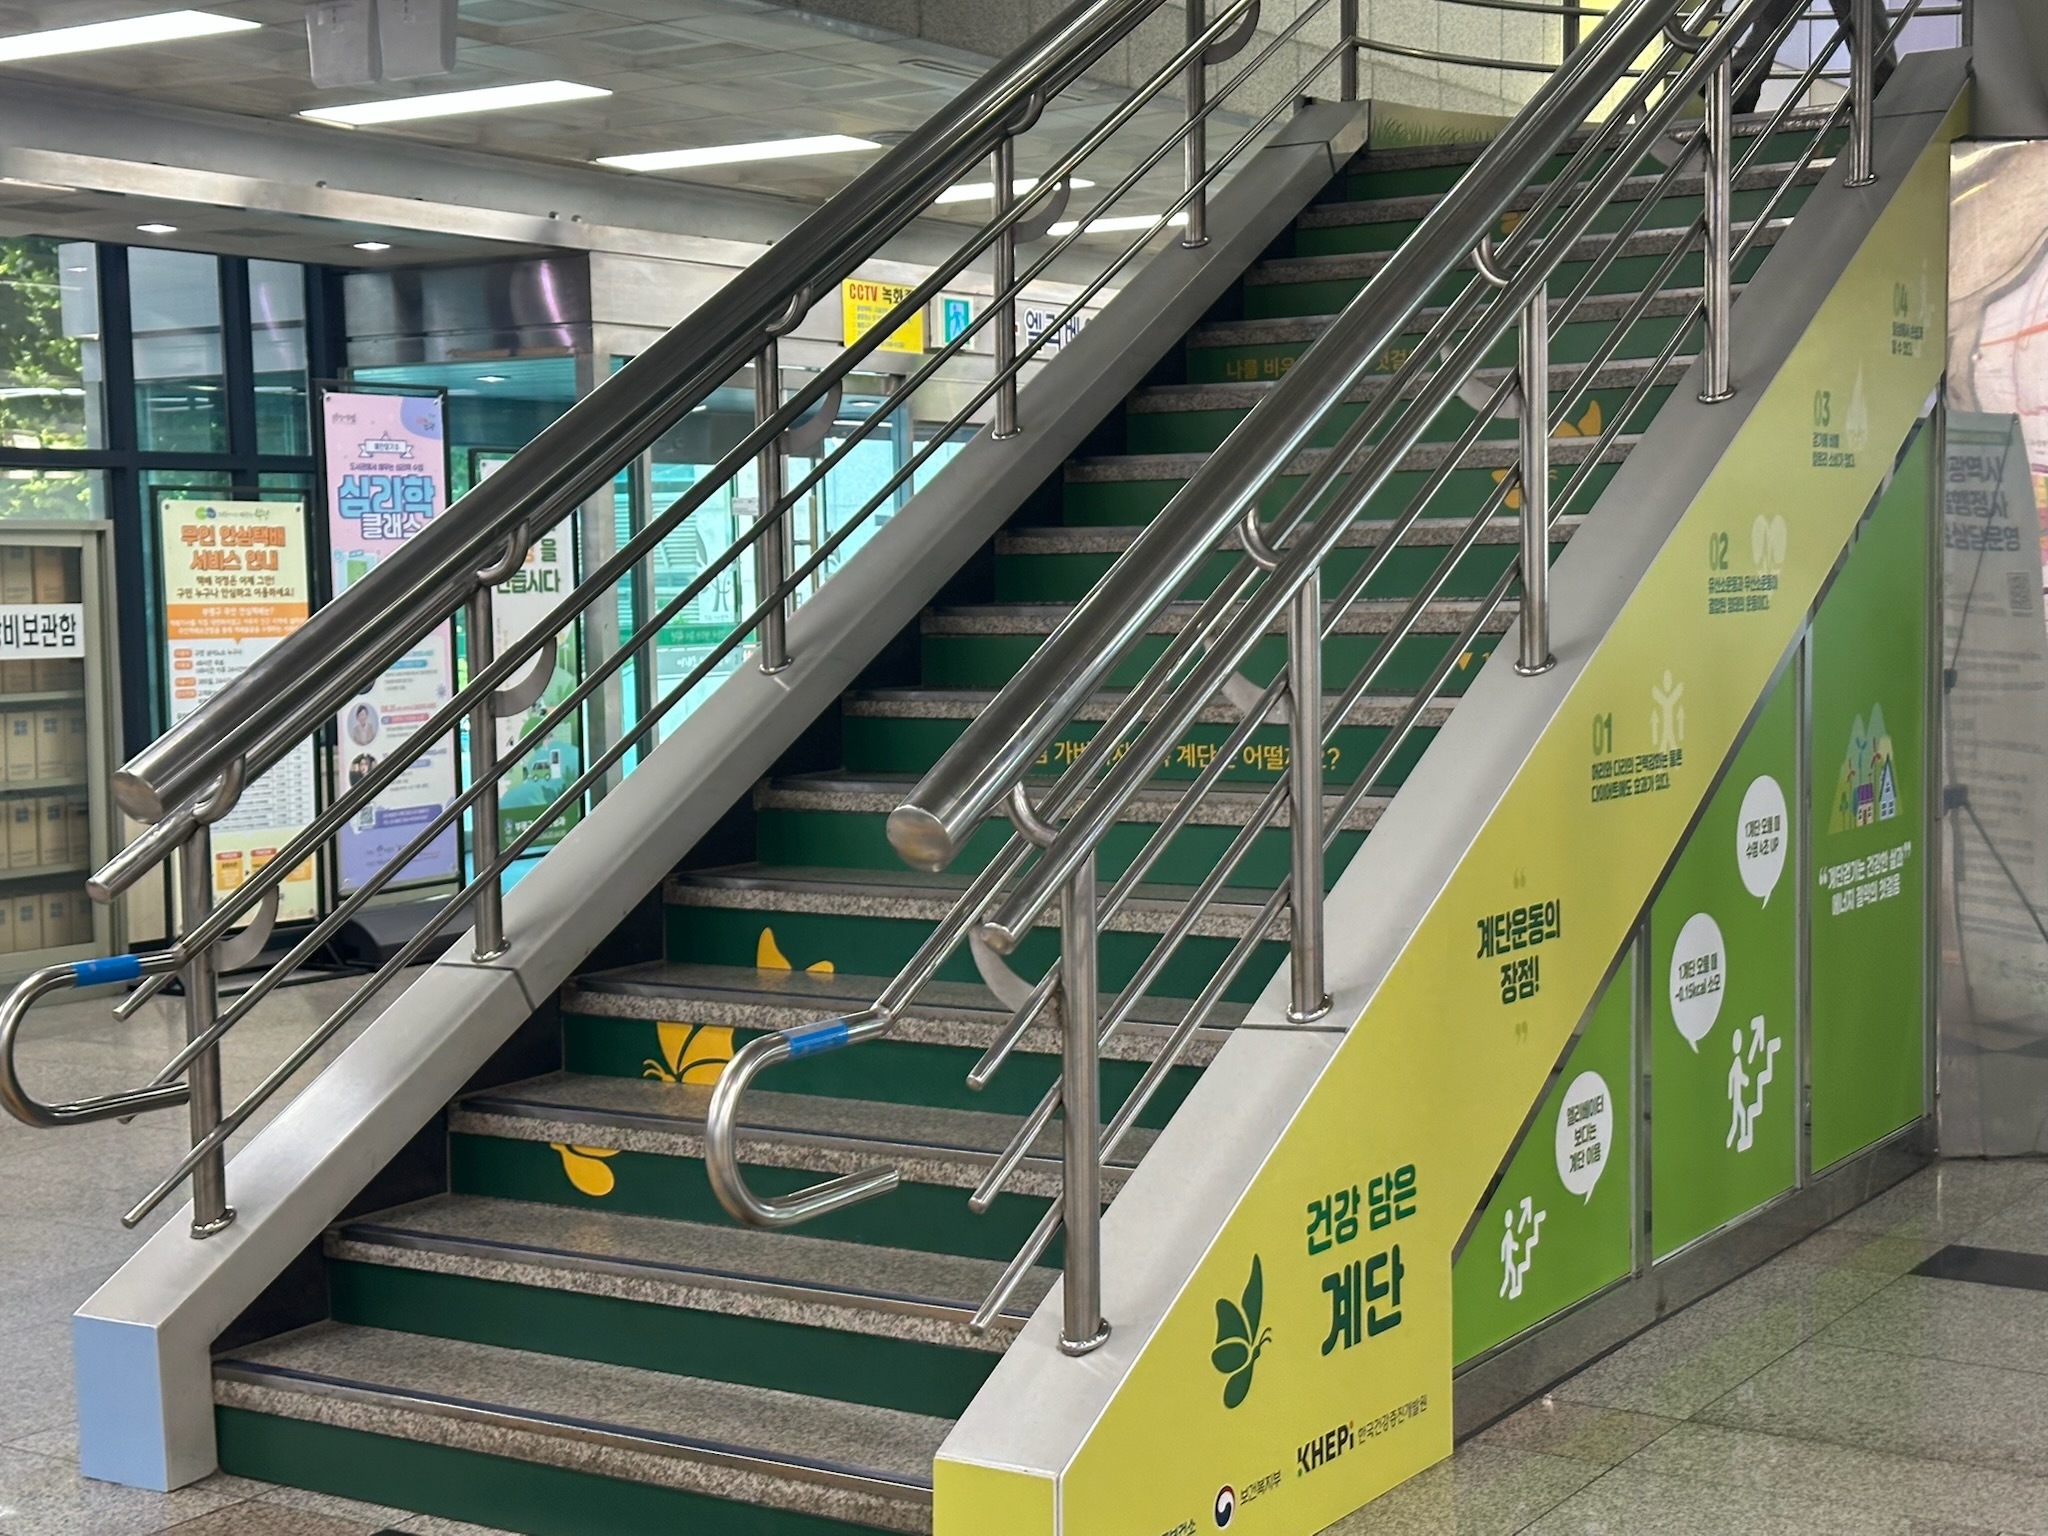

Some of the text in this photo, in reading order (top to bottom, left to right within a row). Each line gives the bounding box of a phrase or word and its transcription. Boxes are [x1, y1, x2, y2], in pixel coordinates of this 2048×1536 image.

[849, 283, 878, 302] CCTV
[1813, 390, 1830, 427] 03
[338, 475, 436, 519] 심리학
[181, 525, 286, 547] 무인 안심택배
[361, 512, 425, 540] 클래스
[190, 550, 279, 571] 서비스 안내
[1709, 532, 1729, 571] 02
[0, 614, 76, 648] 비보관함
[1592, 712, 1612, 755] 01
[1477, 898, 1561, 959] 계단운동의
[1500, 955, 1539, 1005] 장점!
[1567, 1094, 1604, 1127] 엘리베이터
[1574, 1123, 1597, 1147] 보다는
[1569, 1142, 1602, 1174] 계단 이용
[1306, 1163, 1417, 1256] 건강 담은
[1321, 1243, 1405, 1357] 계단
[1357, 1394, 1428, 1445] 한국건강증진개발원
[1240, 1470, 1282, 1505] 보건복지부
